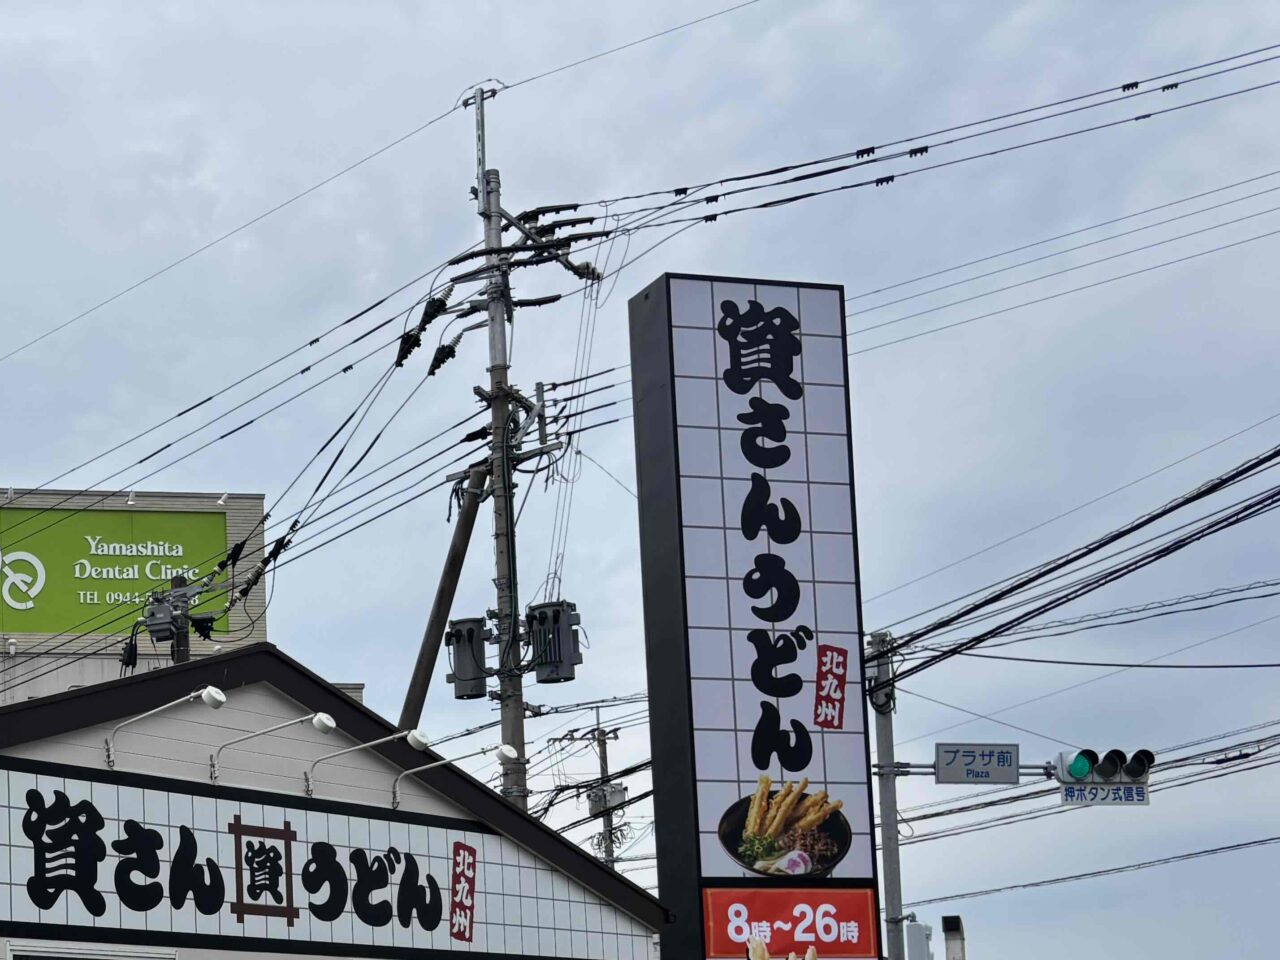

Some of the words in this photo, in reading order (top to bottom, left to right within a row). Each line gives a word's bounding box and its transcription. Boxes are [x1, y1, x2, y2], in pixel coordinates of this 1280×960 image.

[84, 535, 183, 556] Yamashita
[718, 299, 813, 773] 資さんうどん
[73, 559, 139, 579] Dental
[145, 560, 200, 580] Clinic
[78, 591, 101, 604] TEL
[817, 650, 846, 727] 北九州
[944, 750, 1012, 767] プラザ前
[966, 769, 990, 779] Plaza
[1064, 786, 1146, 802] 押ボタン式信号
[451, 847, 475, 941] 北九州
